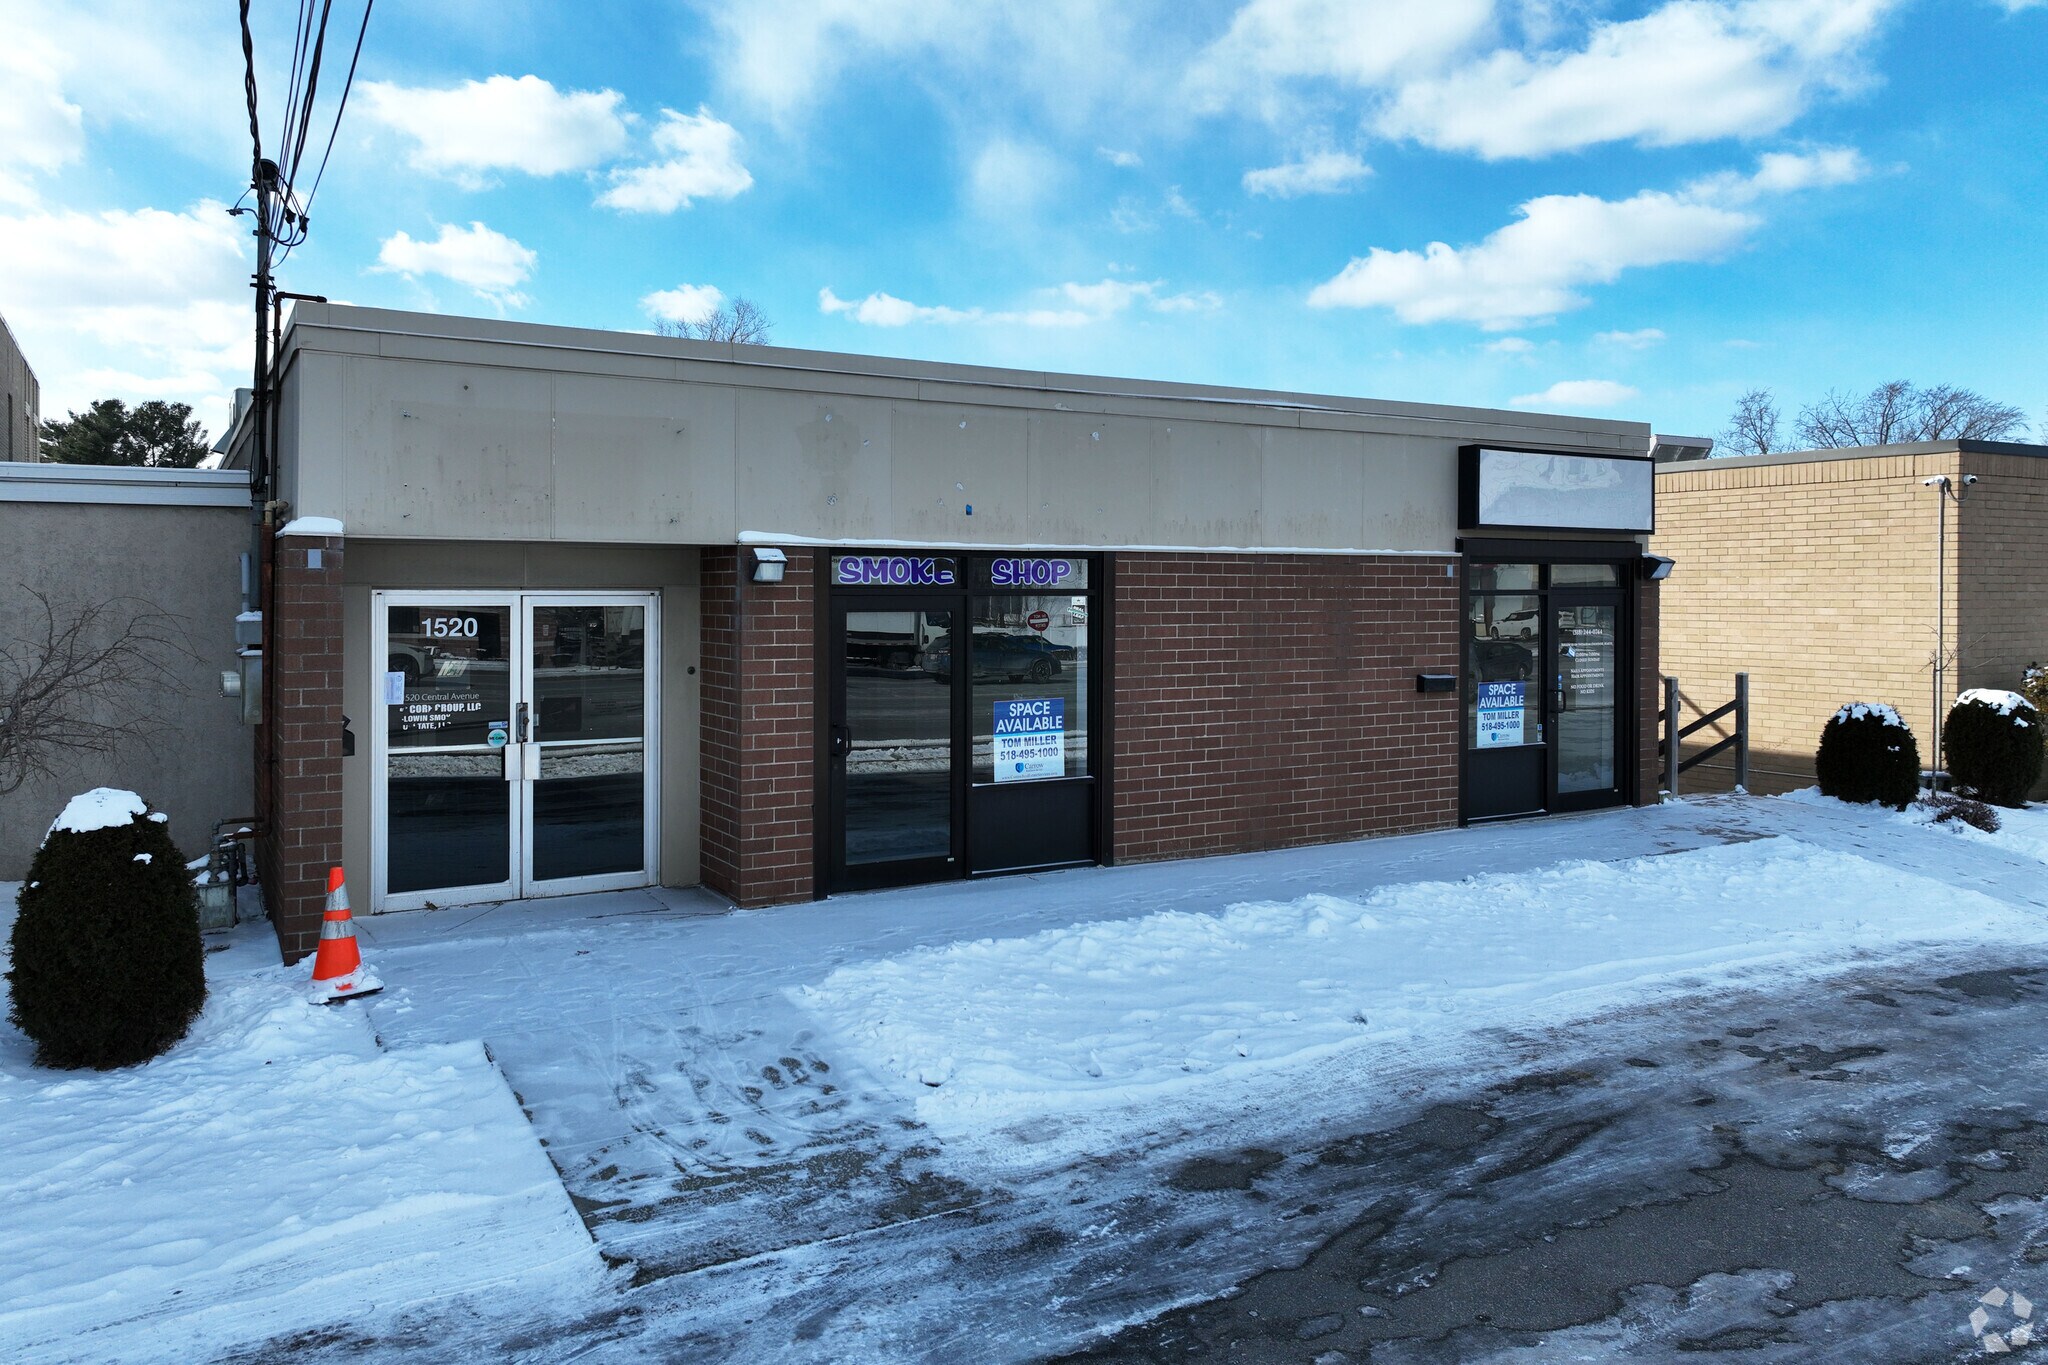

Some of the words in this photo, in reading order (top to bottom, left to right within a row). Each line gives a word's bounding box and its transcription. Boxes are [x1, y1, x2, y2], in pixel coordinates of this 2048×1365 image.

[838, 556, 954, 585] SMOKE
[991, 558, 1071, 586] SHOP
[421, 617, 478, 637] 1520
[1488, 683, 1516, 696] SPACE
[421, 693, 449, 701] Central
[451, 692, 480, 700] Avenue
[1480, 695, 1524, 708] AVAILABLE
[1009, 701, 1051, 717] SPACE
[1483, 711, 1496, 720] TOM
[1497, 711, 1519, 719] MILLER
[996, 715, 1062, 733] AVAILABLE
[1481, 721, 1520, 731] 518-495-1000
[1001, 738, 1021, 748] TOM
[1024, 735, 1057, 747] MILLER
[1000, 747, 1058, 760] 518-495-1000
